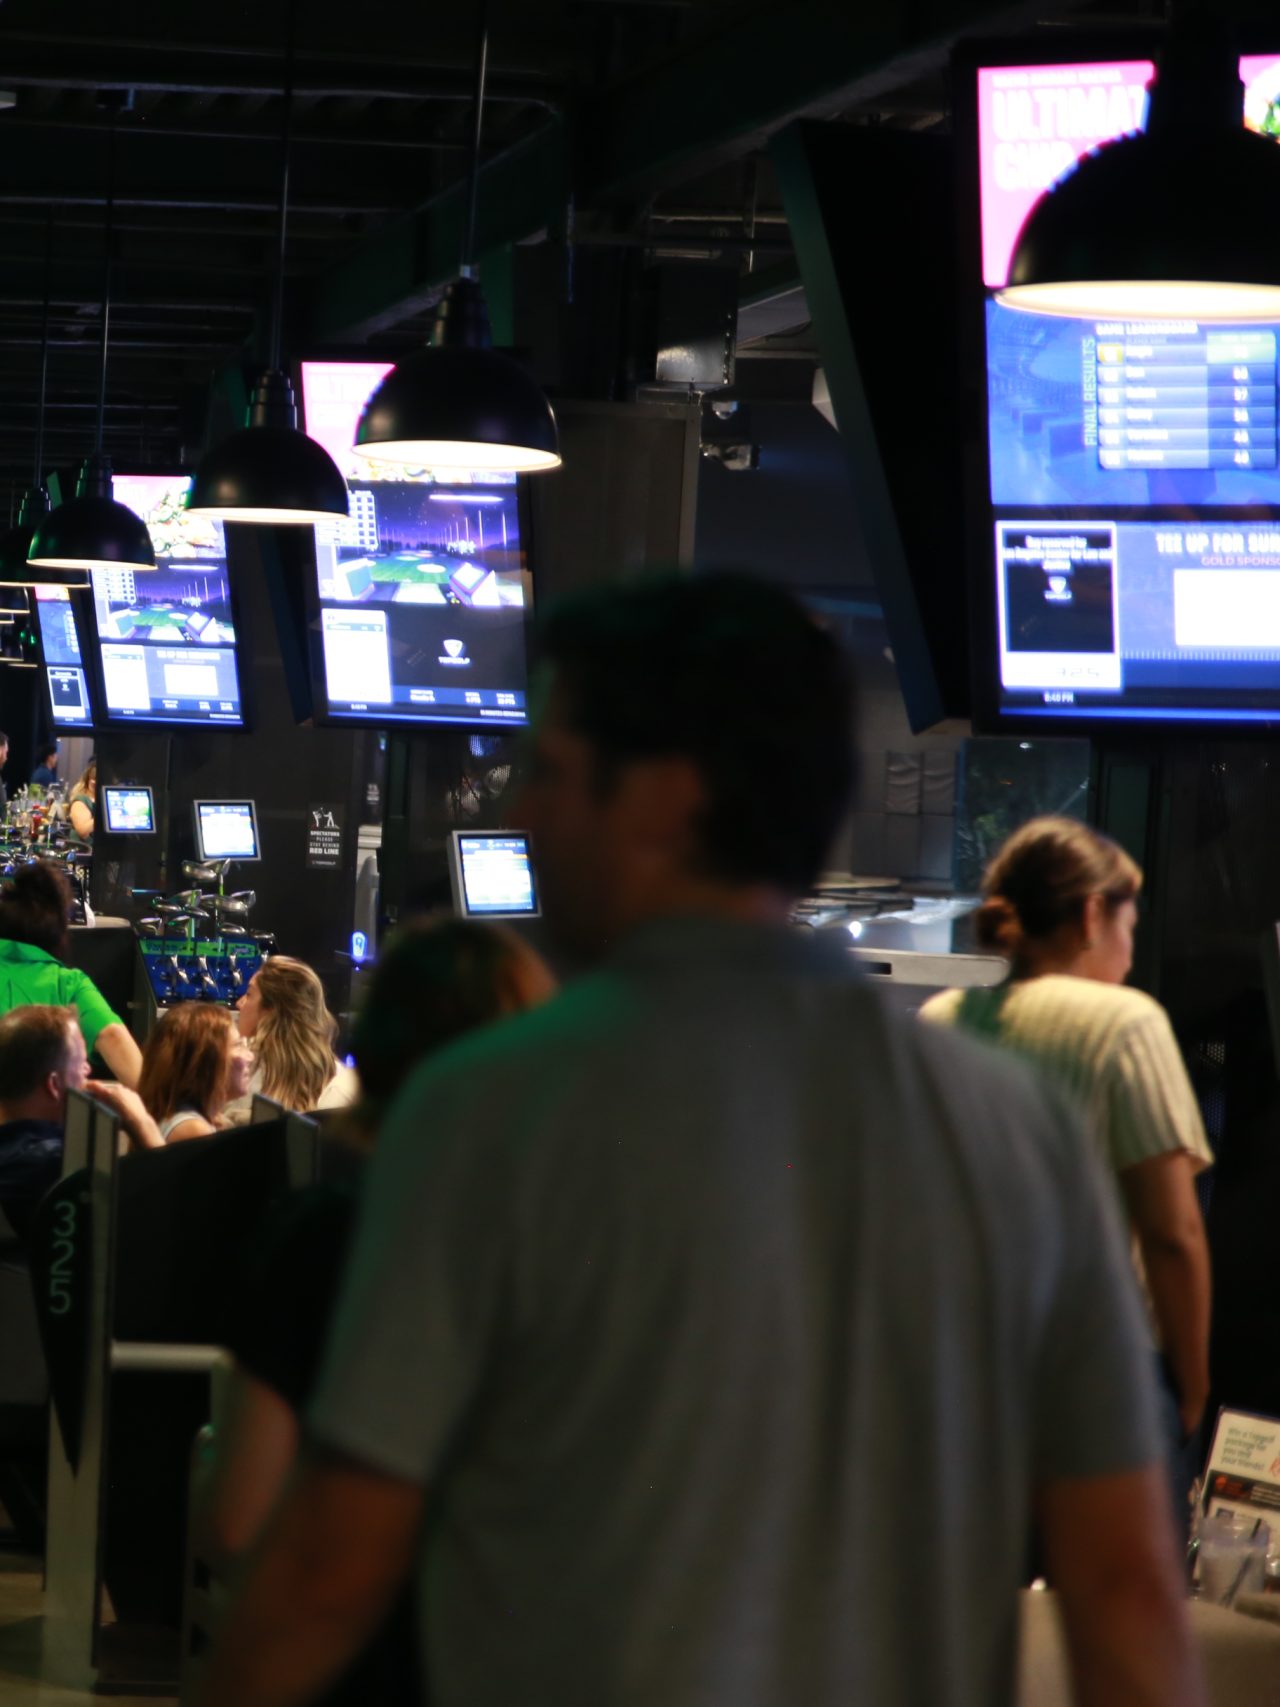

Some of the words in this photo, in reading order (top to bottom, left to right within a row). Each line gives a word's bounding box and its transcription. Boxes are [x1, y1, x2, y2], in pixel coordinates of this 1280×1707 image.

[1082, 338, 1096, 401] RESULTS
[1084, 404, 1097, 446] FINAL
[1186, 532, 1210, 554] UP
[1201, 555, 1235, 567] GOLD
[48, 1200, 77, 1315] 325
